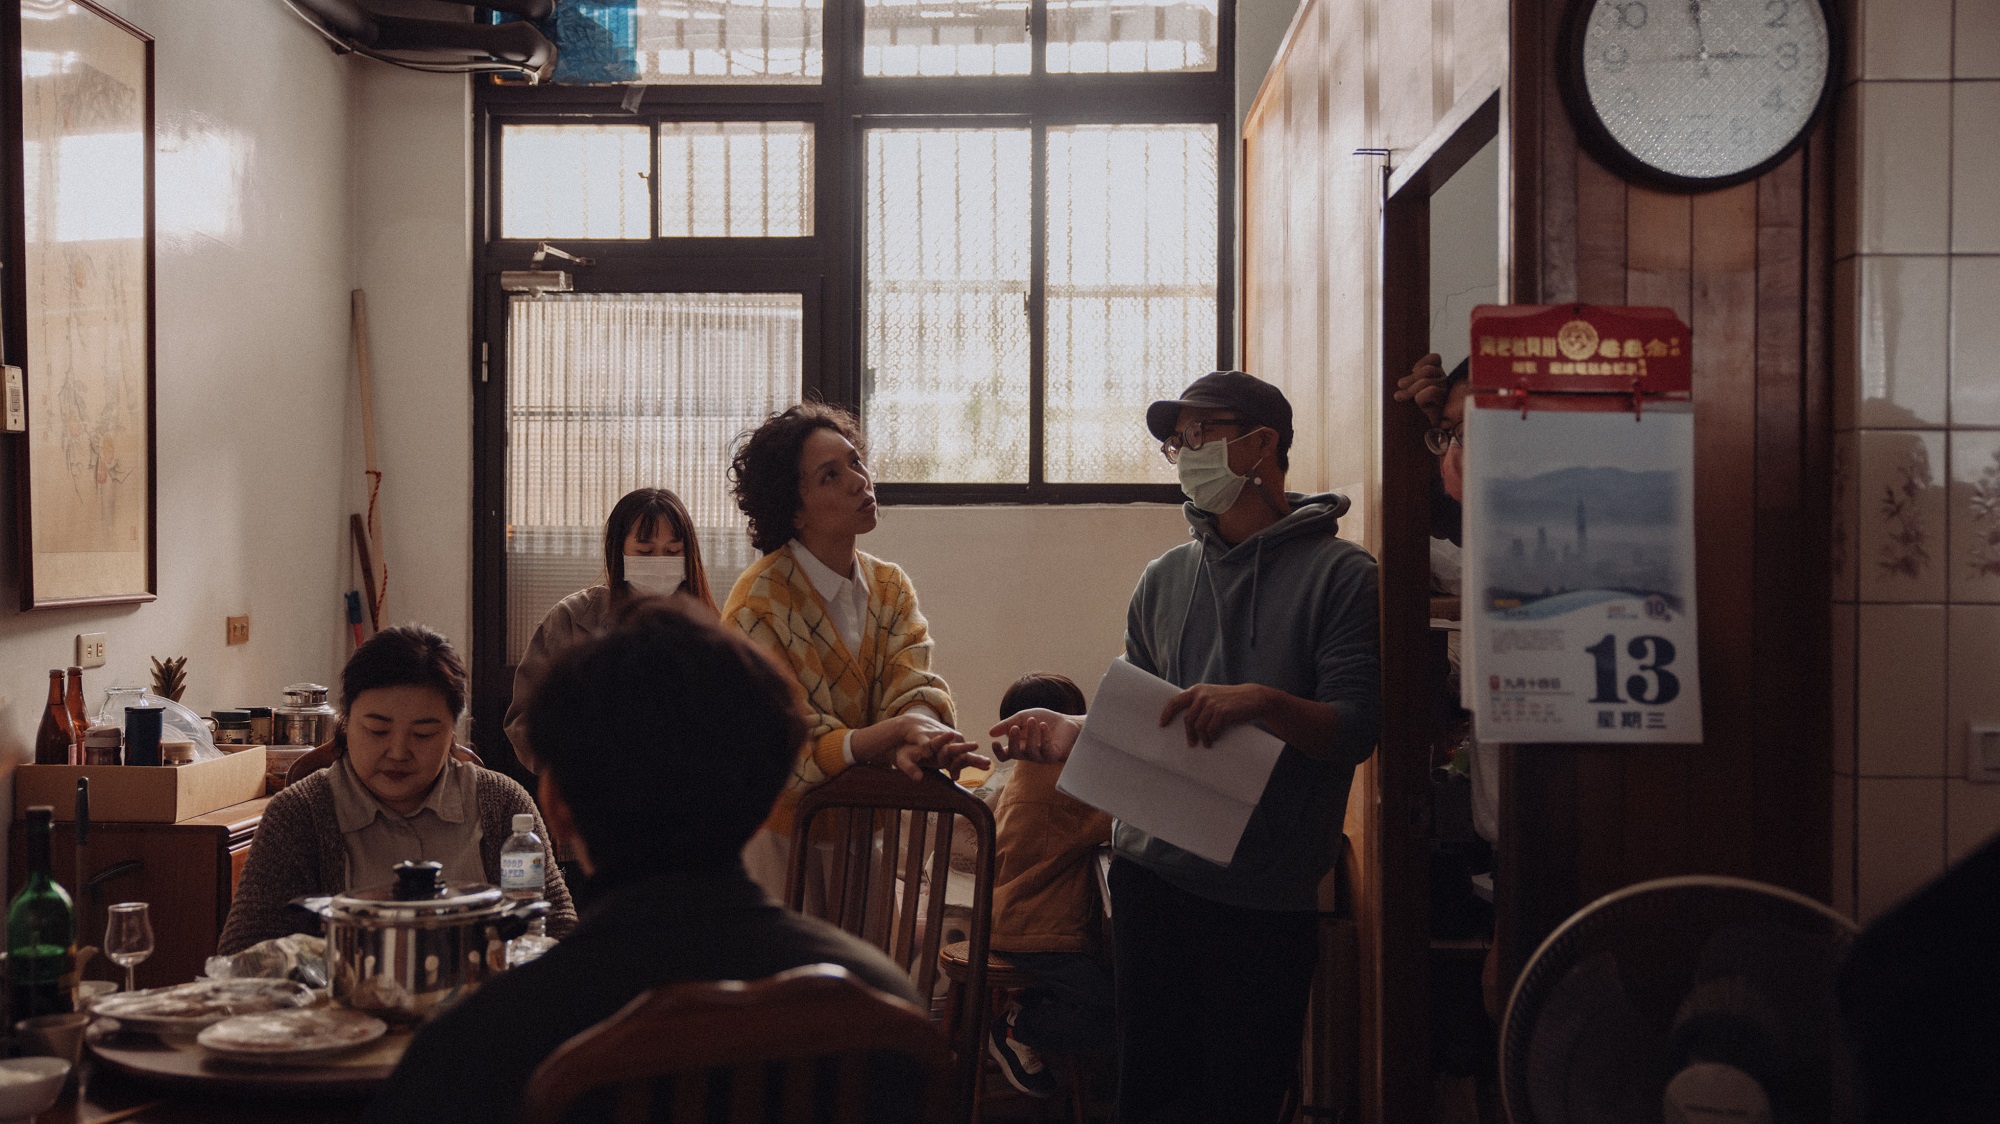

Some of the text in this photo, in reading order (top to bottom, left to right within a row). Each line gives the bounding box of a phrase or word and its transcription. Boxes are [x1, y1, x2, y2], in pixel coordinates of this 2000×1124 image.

[1765, 0, 1788, 28] 2
[1775, 42, 1800, 72] 3
[1585, 634, 1680, 706] 13
[1597, 710, 1667, 729] 星期三
